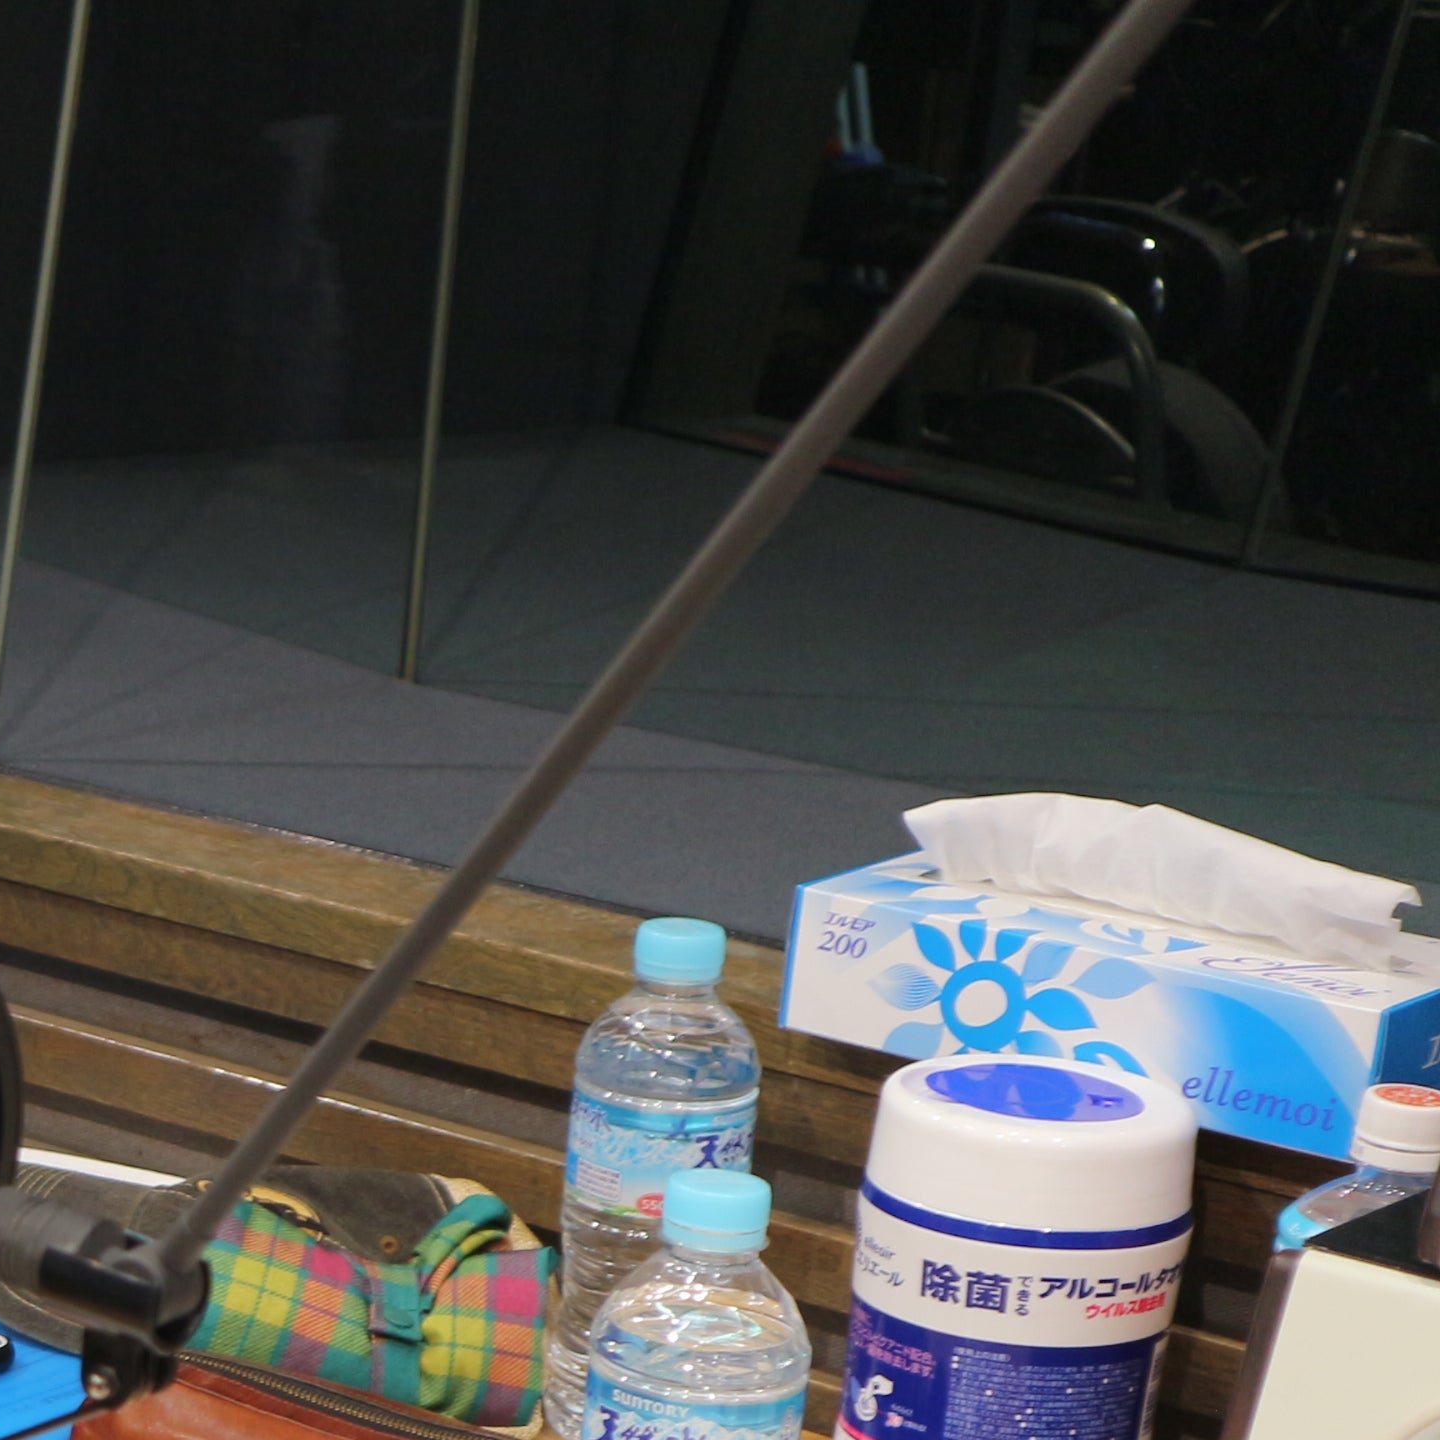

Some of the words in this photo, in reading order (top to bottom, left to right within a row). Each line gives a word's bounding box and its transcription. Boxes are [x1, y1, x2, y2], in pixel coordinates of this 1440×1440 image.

[817, 930, 867, 958] 200
[1181, 1066, 1339, 1132] ellemoi
[920, 1258, 1012, 1314] 除菌
[1016, 1275, 1030, 1317] できる
[1038, 1264, 1185, 1300] アルコールタオ
[611, 1388, 690, 1418] SUNTORY
